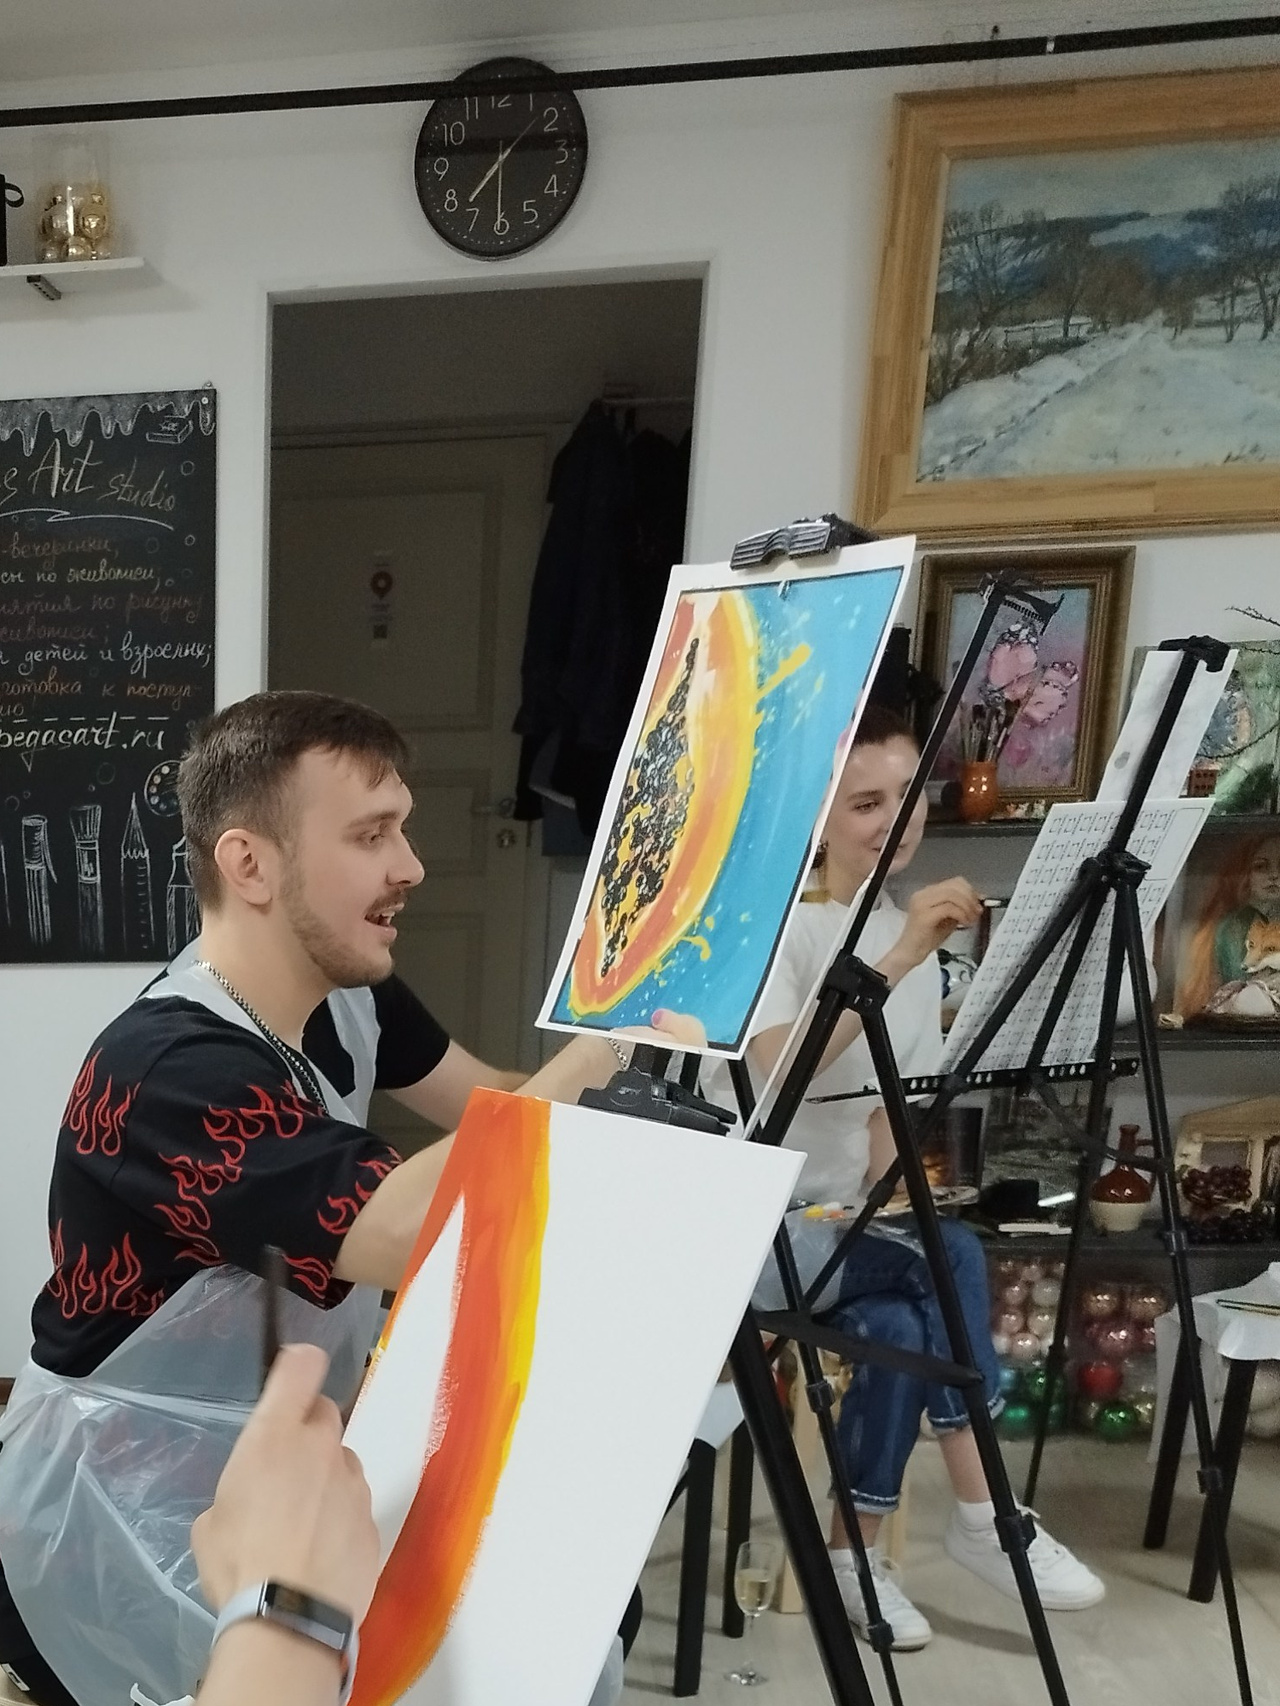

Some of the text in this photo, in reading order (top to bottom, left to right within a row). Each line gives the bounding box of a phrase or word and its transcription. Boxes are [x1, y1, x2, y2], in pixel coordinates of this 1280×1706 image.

[464, 96, 479, 121] 11
[543, 107, 559, 132] 2
[442, 121, 465, 147] 10
[555, 139, 569, 164] 3
[433, 157, 449, 181] 9
[543, 174, 559, 197] 4
[444, 188, 458, 212] 8
[523, 199, 539, 224] 5
[466, 208, 479, 232] 7
[494, 211, 509, 235] 6
[28, 438, 103, 498] Art
[36, 571, 57, 583] по
[91, 595, 115, 610] по
[18, 644, 88, 676] детей
[99, 648, 115, 662] и
[101, 683, 116, 698] к
